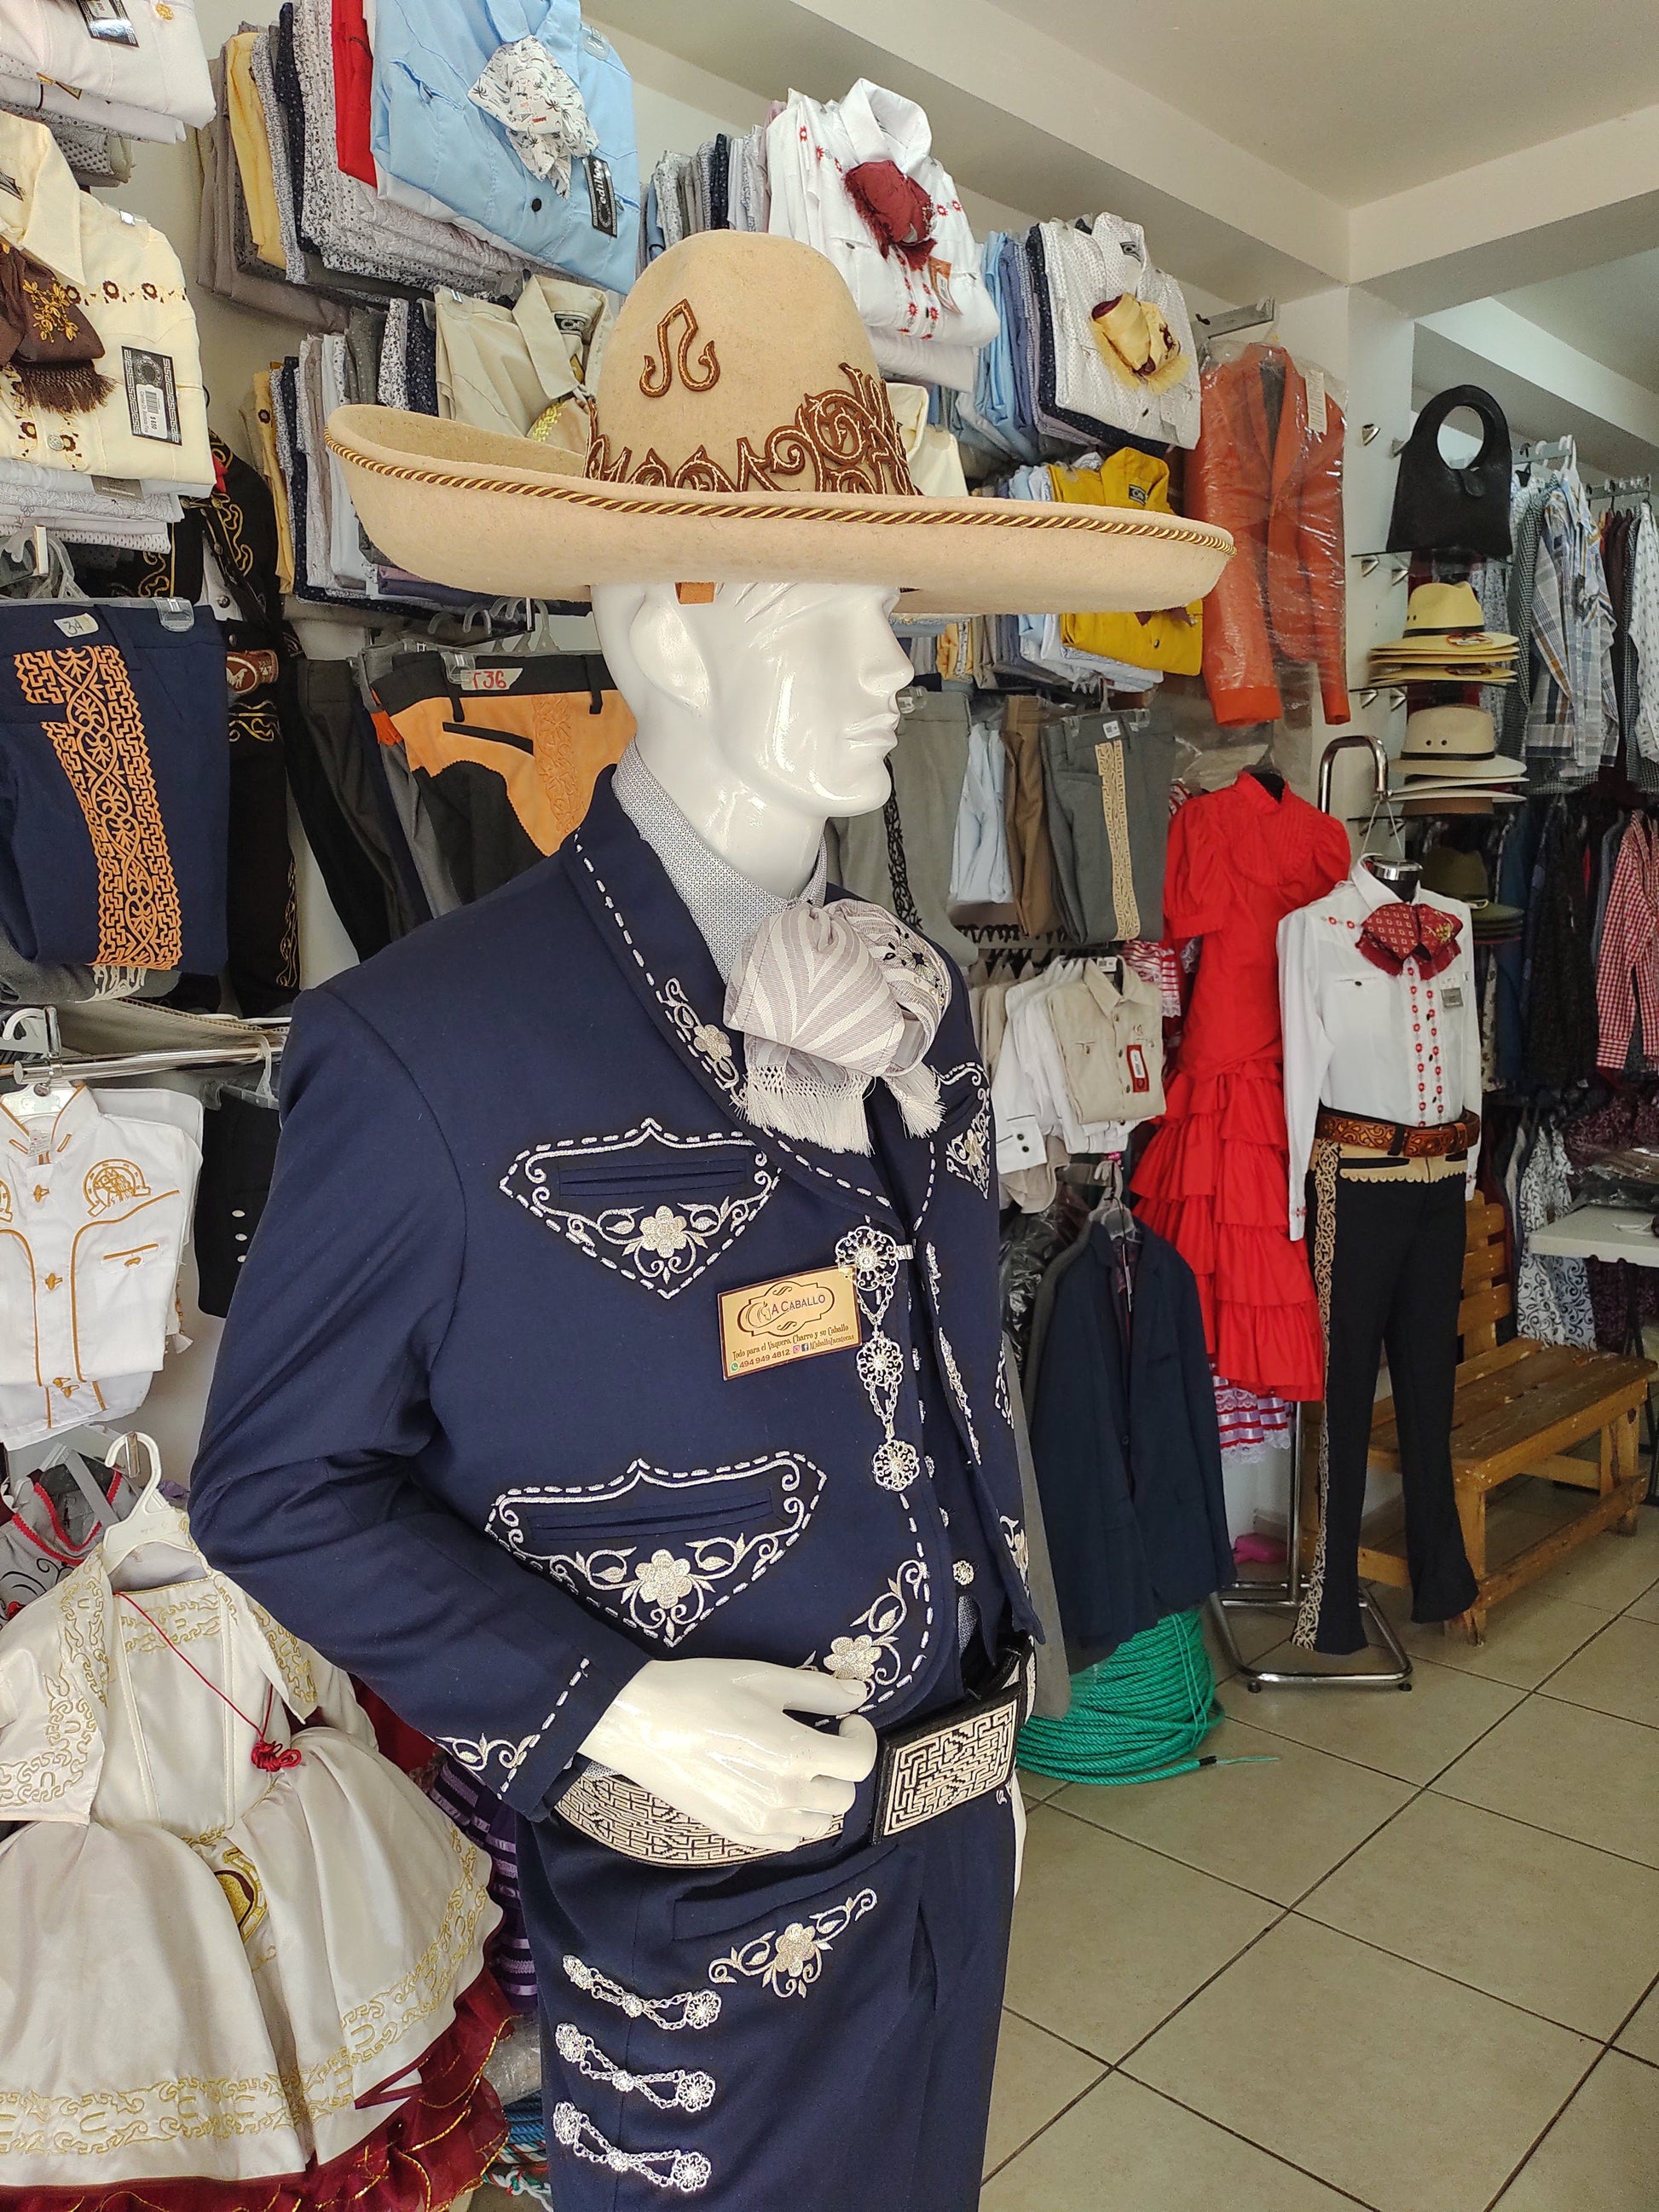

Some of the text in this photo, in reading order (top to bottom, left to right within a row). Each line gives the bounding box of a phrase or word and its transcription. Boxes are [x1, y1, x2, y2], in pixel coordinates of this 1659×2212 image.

[62, 618, 85, 635] 34
[772, 1303, 779, 1315] A
[732, 1349, 746, 1361] Todo
[747, 1347, 760, 1357] para
[761, 1343, 766, 1351] el
[793, 1334, 813, 1344] Charro
[814, 1331, 818, 1340] y
[827, 1323, 849, 1337] Caballo
[739, 1359, 754, 1368] 494
[755, 1354, 771, 1364] 949
[772, 1349, 791, 1359] 4812
